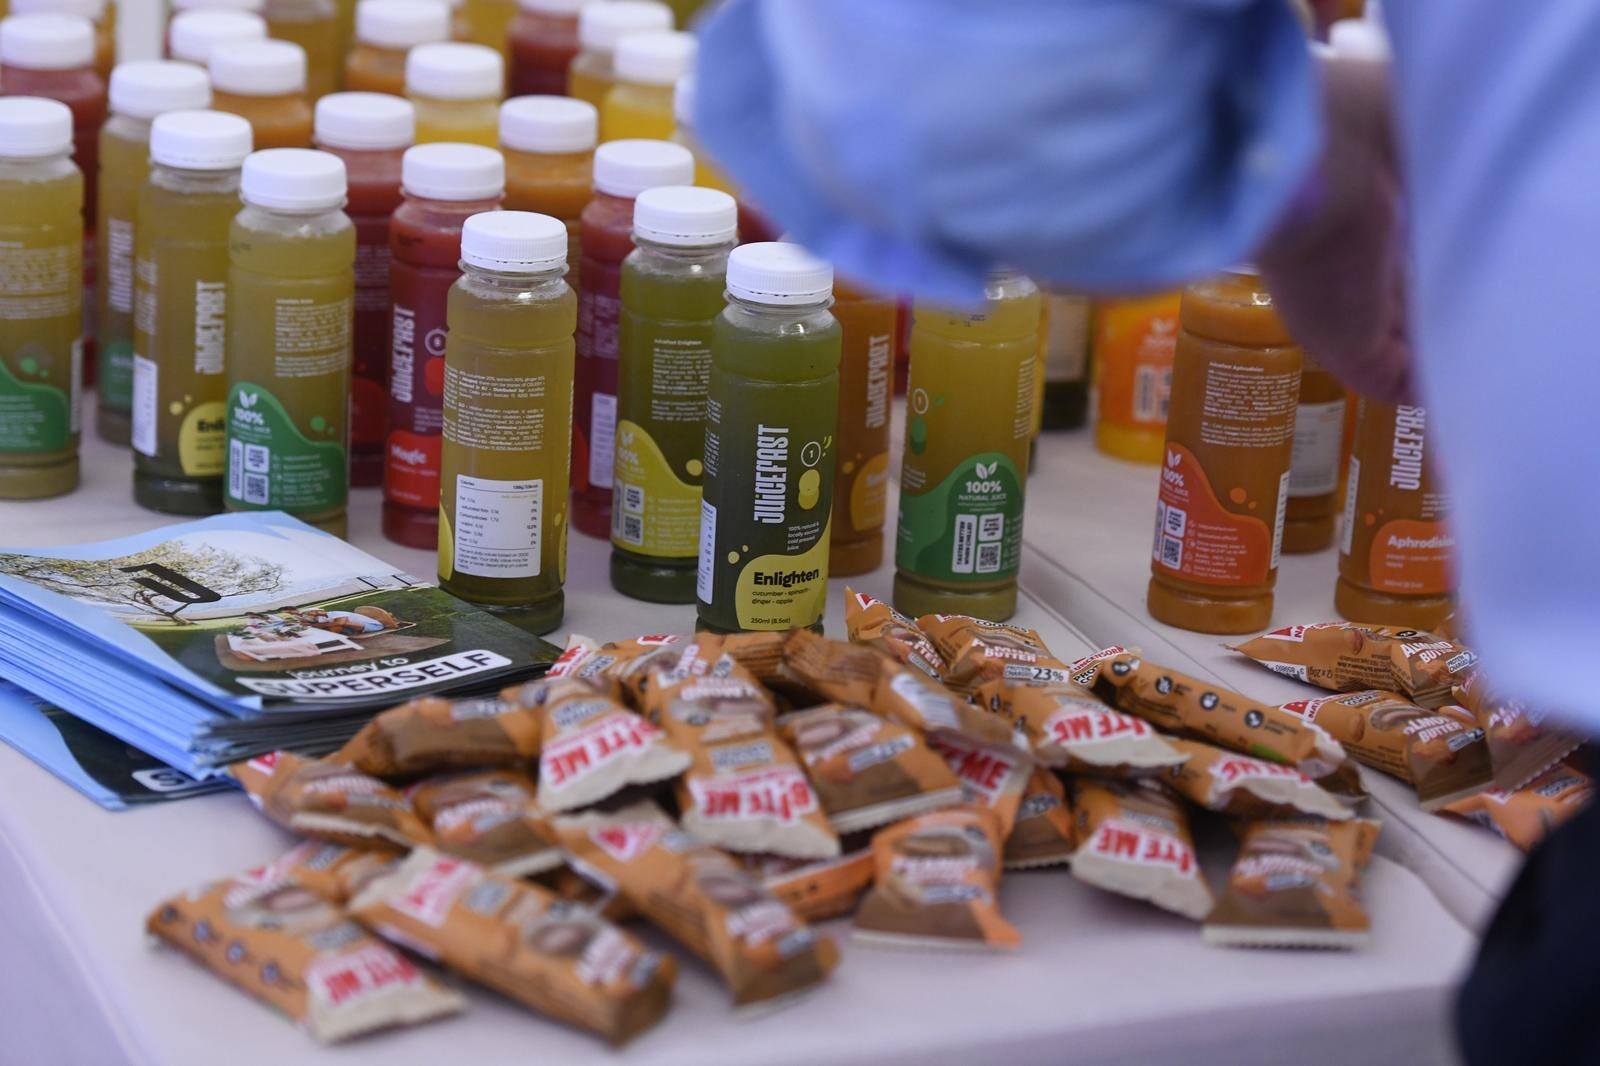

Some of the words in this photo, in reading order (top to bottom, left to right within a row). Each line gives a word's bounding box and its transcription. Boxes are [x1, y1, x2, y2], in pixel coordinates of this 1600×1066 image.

[965, 480, 1002, 494] 100%
[1388, 535, 1455, 549] Aphrodisia
[753, 568, 820, 588] Enlighten
[984, 648, 1037, 663] BUTTER
[253, 653, 494, 698] SUPERSELF
[287, 661, 379, 680] journey
[380, 656, 409, 668] to
[1033, 667, 1065, 681] 23%
[1053, 714, 1093, 742] ME
[1418, 720, 1463, 744] BUTTER
[548, 746, 590, 785] ME
[959, 751, 1012, 791] ME
[704, 789, 742, 817] ME
[1098, 826, 1141, 852] ME
